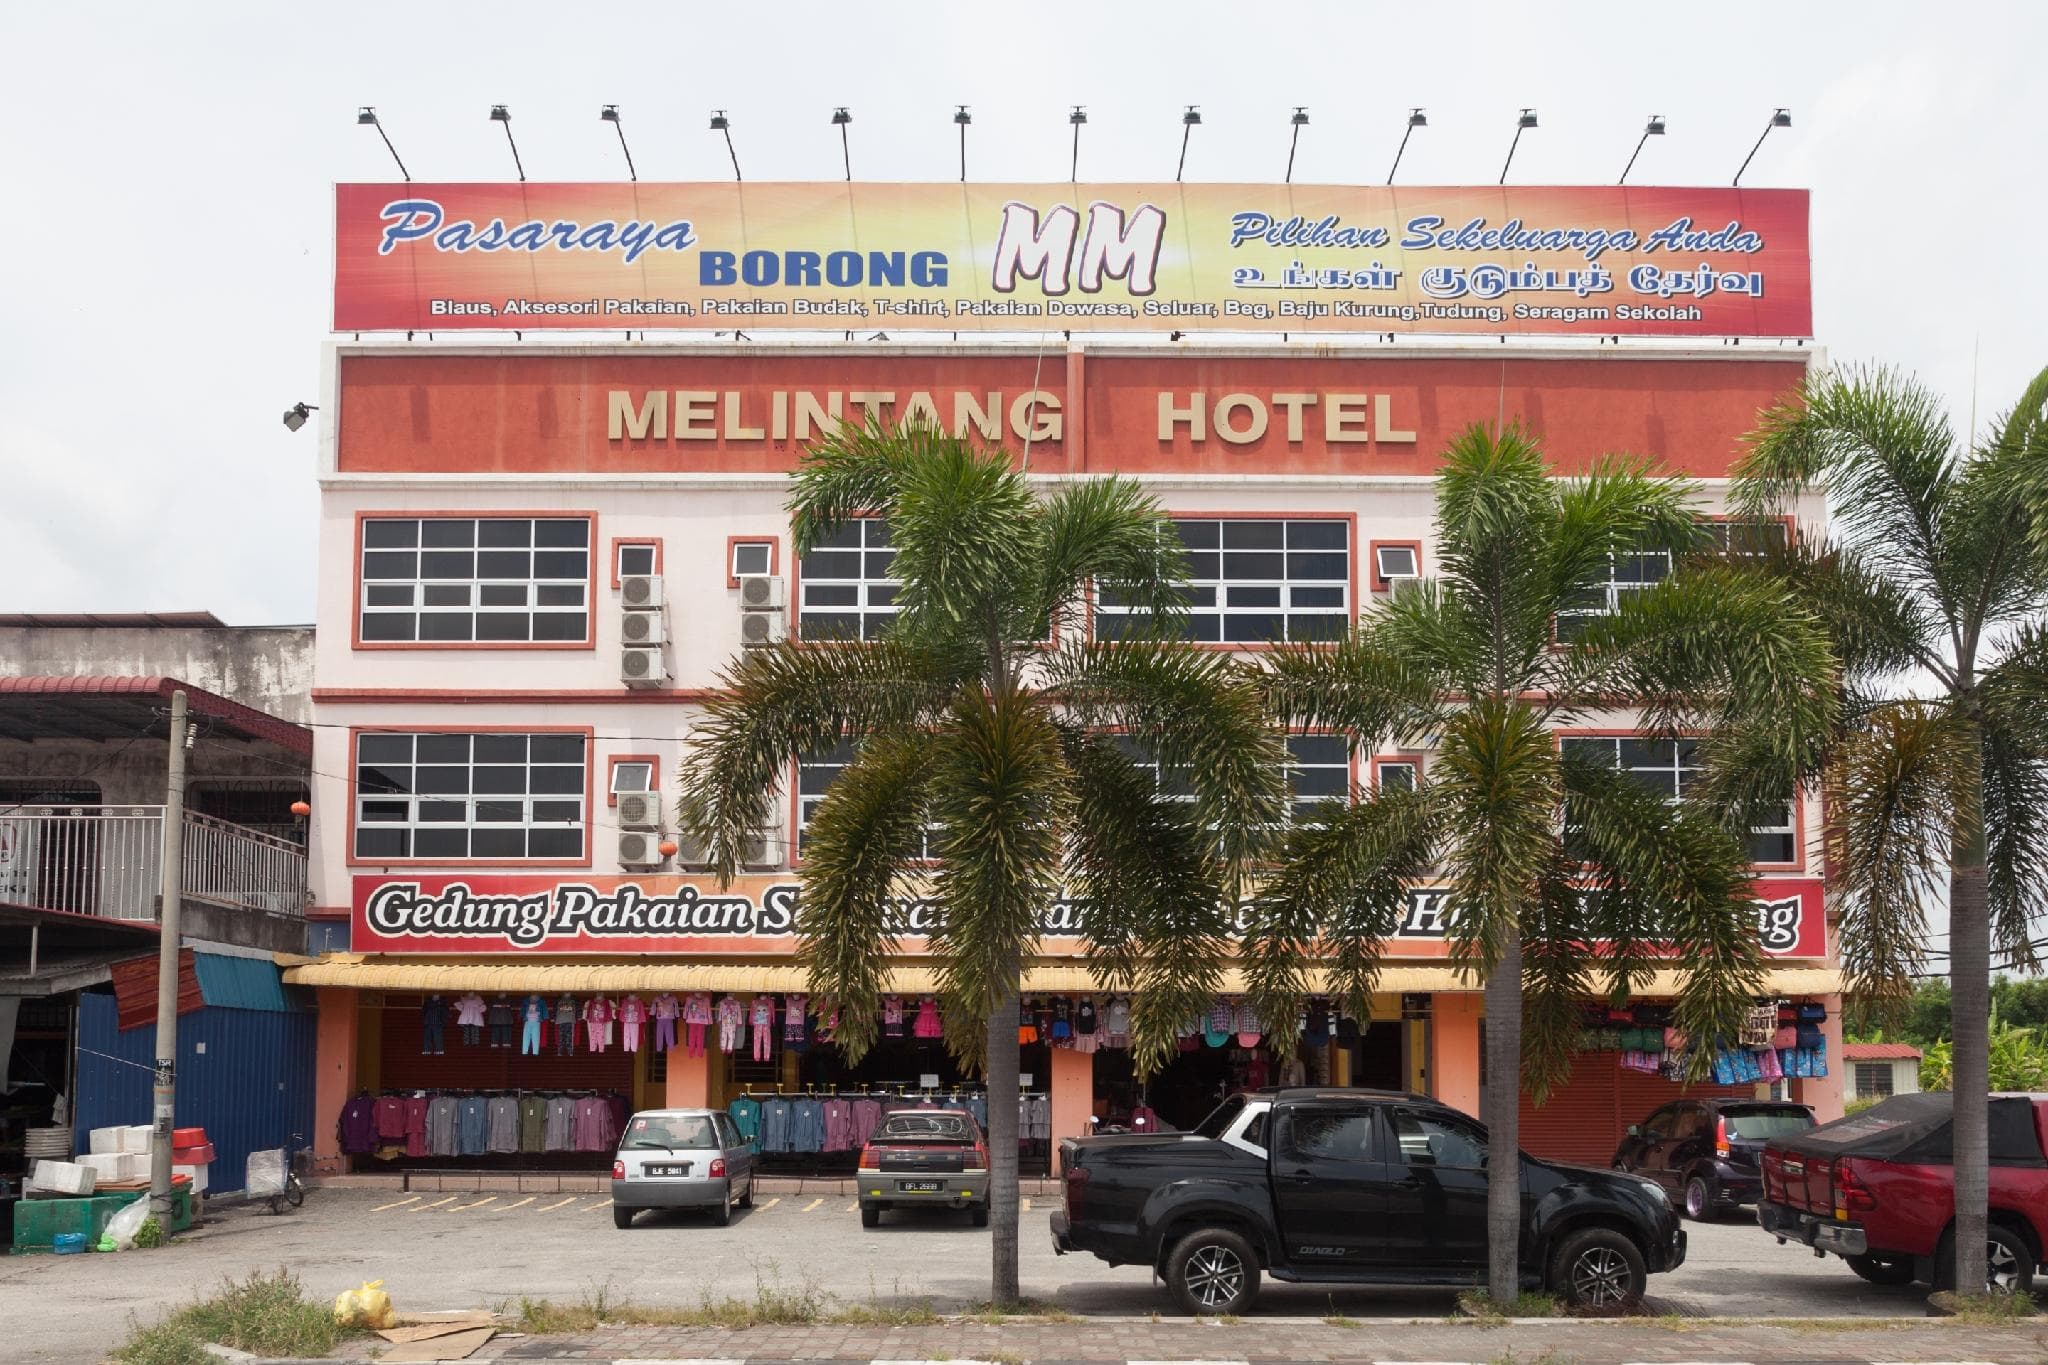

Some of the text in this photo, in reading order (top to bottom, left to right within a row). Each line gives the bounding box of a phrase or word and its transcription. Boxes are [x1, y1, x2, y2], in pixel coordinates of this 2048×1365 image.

[379, 199, 697, 264] Pasaraya
[992, 202, 1166, 296] MM
[1231, 212, 1765, 260] Pilihan Sekeluarga Anda
[699, 250, 949, 287] BORONG
[1232, 260, 1401, 289] உங்கள்
[431, 299, 498, 316] Blaus,
[502, 299, 599, 315] Aksesori
[603, 299, 695, 316] Pakaian,
[701, 299, 787, 315] Pakaian
[793, 299, 869, 316] Budak,
[873, 299, 950, 317] T-shirt,
[1047, 300, 1138, 318] Dewasa,
[1143, 300, 1219, 318] Seluar,
[1224, 300, 1273, 318] Beg,
[1279, 300, 1328, 320] Baju
[1513, 304, 1609, 322] Seragam
[1615, 304, 1702, 321] Sekolah
[608, 391, 1416, 444] MELINTANG HOTEL
[368, 884, 549, 946] Gedung
[551, 883, 753, 934] Pakaian
